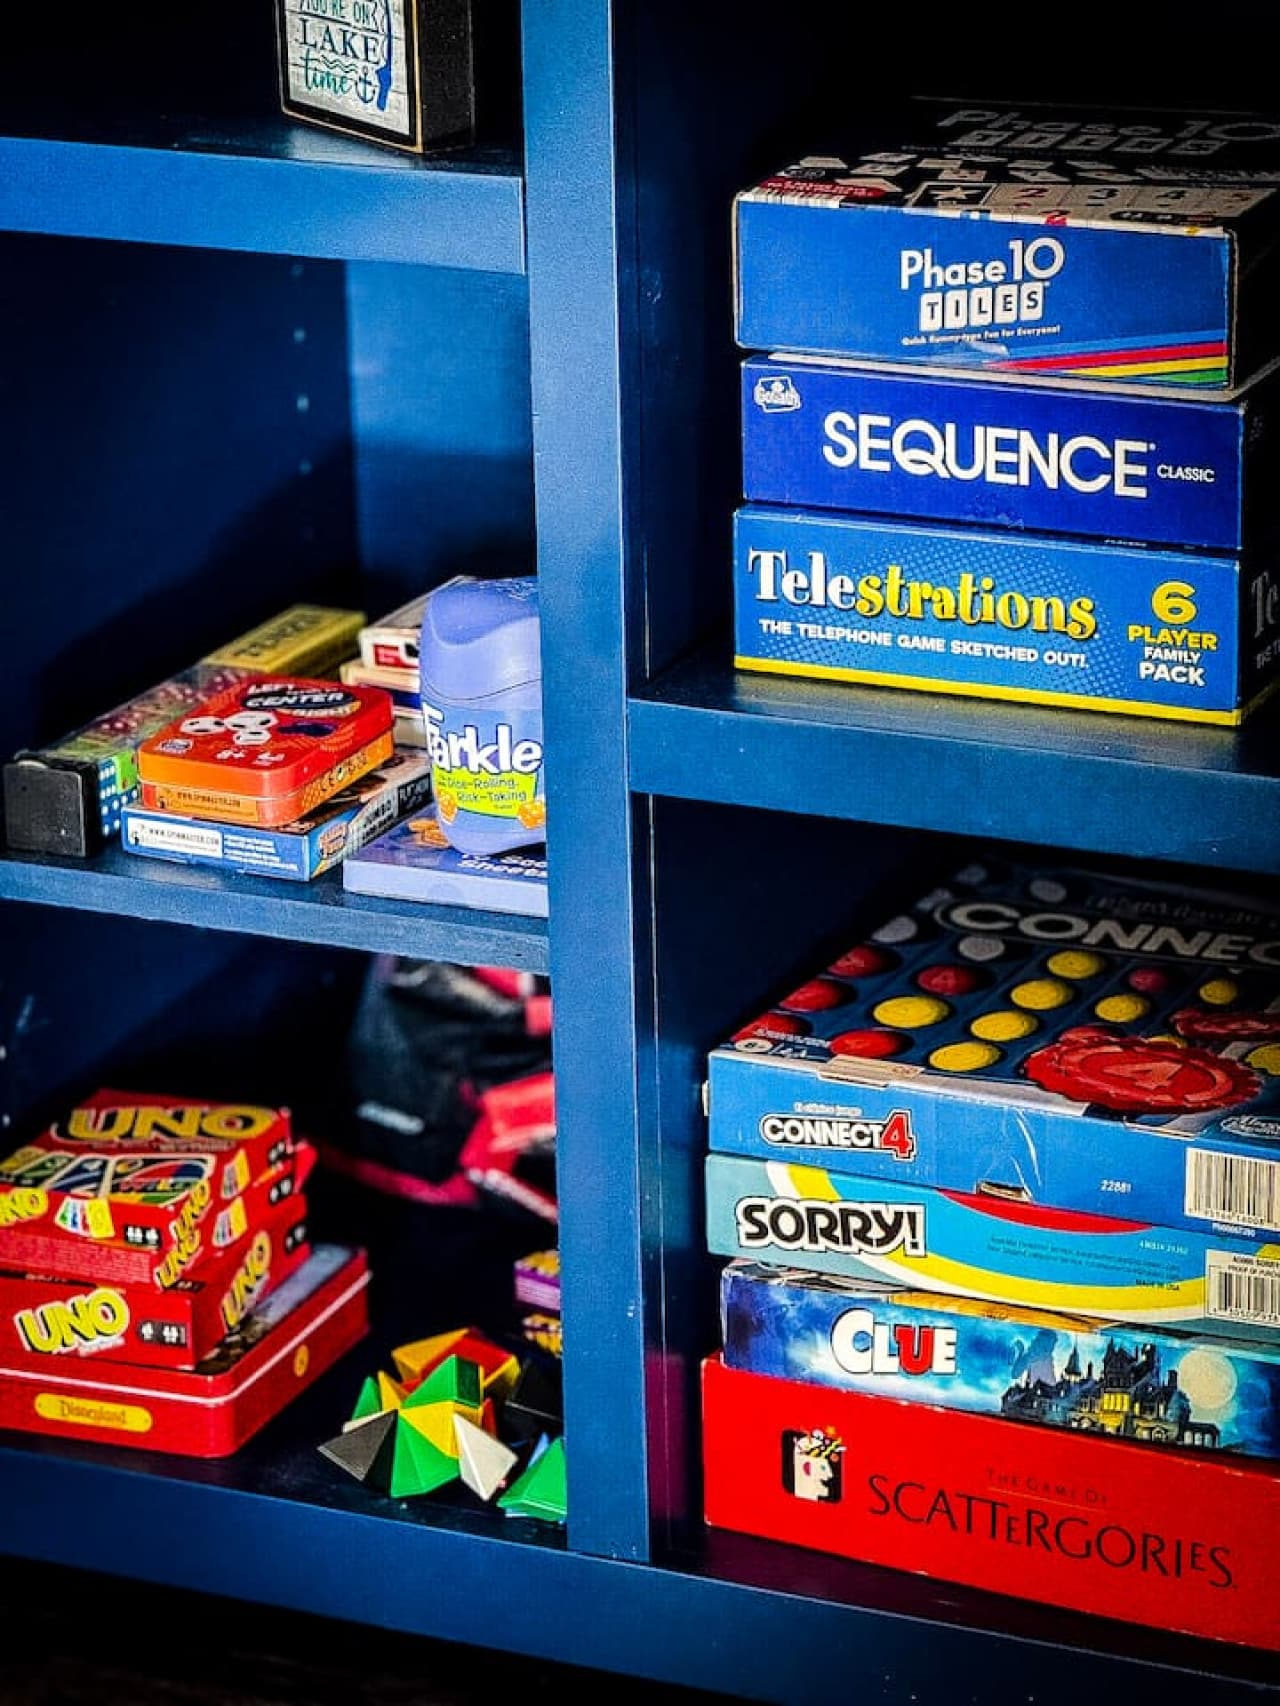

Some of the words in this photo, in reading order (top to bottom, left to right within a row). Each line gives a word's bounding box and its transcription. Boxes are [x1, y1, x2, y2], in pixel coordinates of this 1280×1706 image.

[298, 17, 381, 65] LAKE
[299, 47, 353, 95] time
[900, 247, 1007, 290] Phase
[1009, 237, 1065, 280] 10
[922, 286, 1042, 326] TILES
[822, 410, 1149, 498] SEQUENCE
[1156, 464, 1215, 482] CLASSIC
[749, 549, 1097, 640] Telestrations
[1151, 580, 1198, 625] 6
[759, 620, 793, 635] THE
[797, 623, 892, 646] TELEPHONE
[898, 636, 945, 652] GAME
[950, 640, 1038, 662] SKETCHED
[1043, 652, 1087, 668] OUT!
[1127, 624, 1218, 651] PLAYER
[1144, 646, 1201, 665] FAMILY
[1139, 661, 1206, 687] PACK
[245, 691, 345, 708] CENTER
[422, 701, 543, 775] Farkle
[66, 1105, 276, 1141] UNO
[762, 1117, 884, 1149] CONNECT
[881, 1112, 915, 1159] 4
[742, 1203, 921, 1251] SORRY!
[158, 1229, 201, 1288] UNO
[222, 1232, 271, 1327] UNO
[18, 1287, 129, 1352] UNO
[830, 1307, 958, 1376] CLUE
[867, 1473, 1237, 1590] SCATTERGORIES
